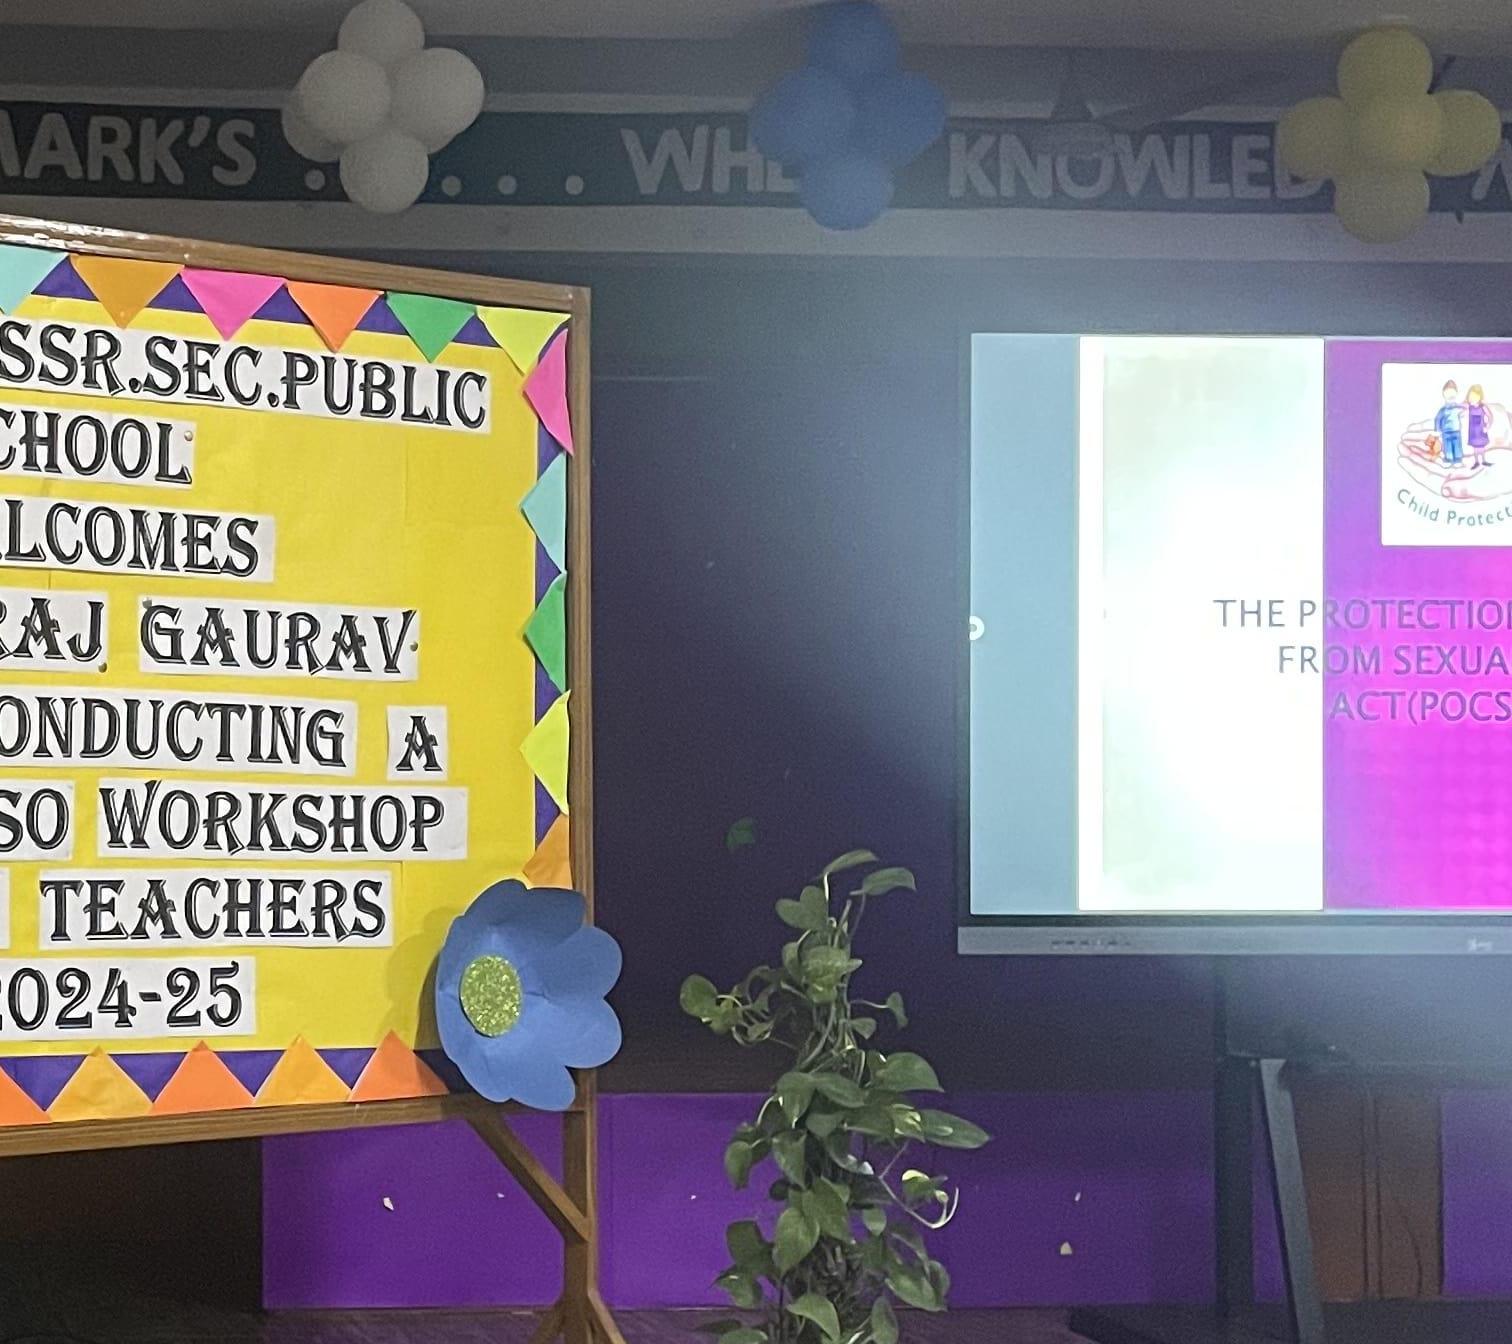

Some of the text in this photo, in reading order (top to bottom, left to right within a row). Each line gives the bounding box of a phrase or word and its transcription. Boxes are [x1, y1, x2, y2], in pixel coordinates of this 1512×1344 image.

[1397, 488, 1440, 522] Child
[140, 604, 416, 674] GAURAV
[1212, 598, 1512, 630] THE PROTECTIO
[1278, 643, 1511, 676] FROM SEXUA
[396, 714, 441, 772] A
[99, 779, 445, 853] WORKSHOP
[39, 877, 386, 942] TEACHERS
